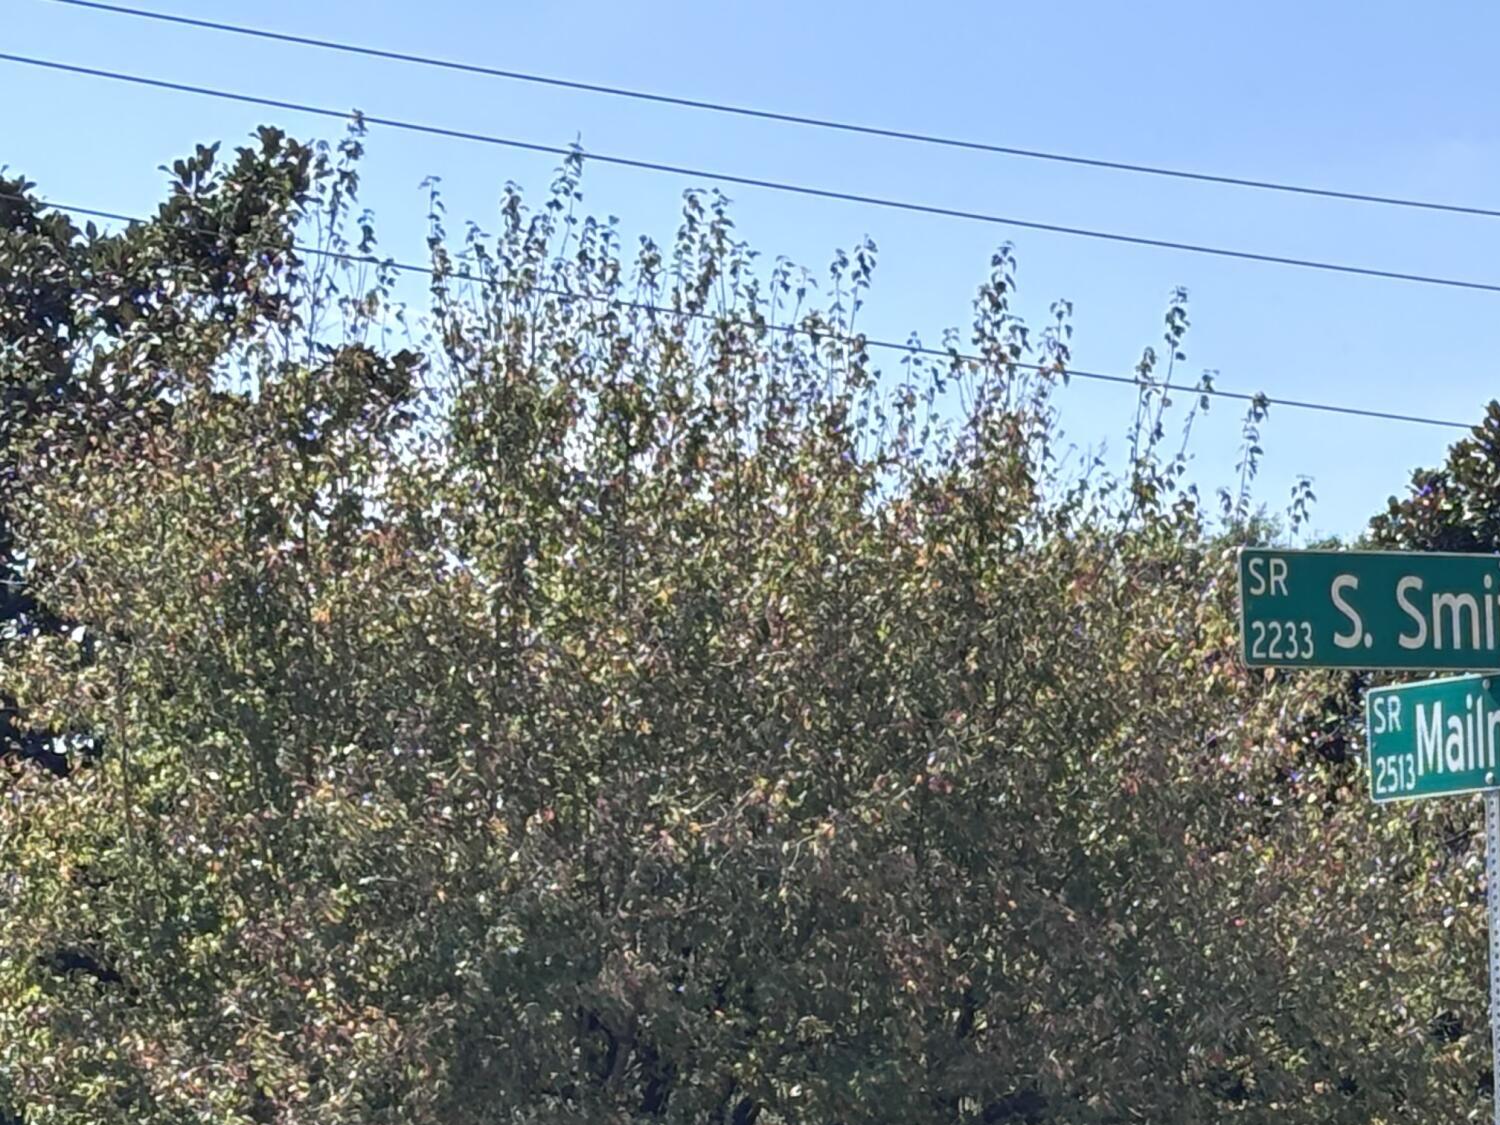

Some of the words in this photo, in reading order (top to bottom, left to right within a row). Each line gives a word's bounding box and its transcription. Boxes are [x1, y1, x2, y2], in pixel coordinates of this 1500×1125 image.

[1249, 557, 1289, 597] SR
[1331, 574, 1373, 650] S.
[1251, 620, 1315, 660] 2233
[1373, 694, 1402, 735] SR
[1375, 752, 1416, 795] 2513
